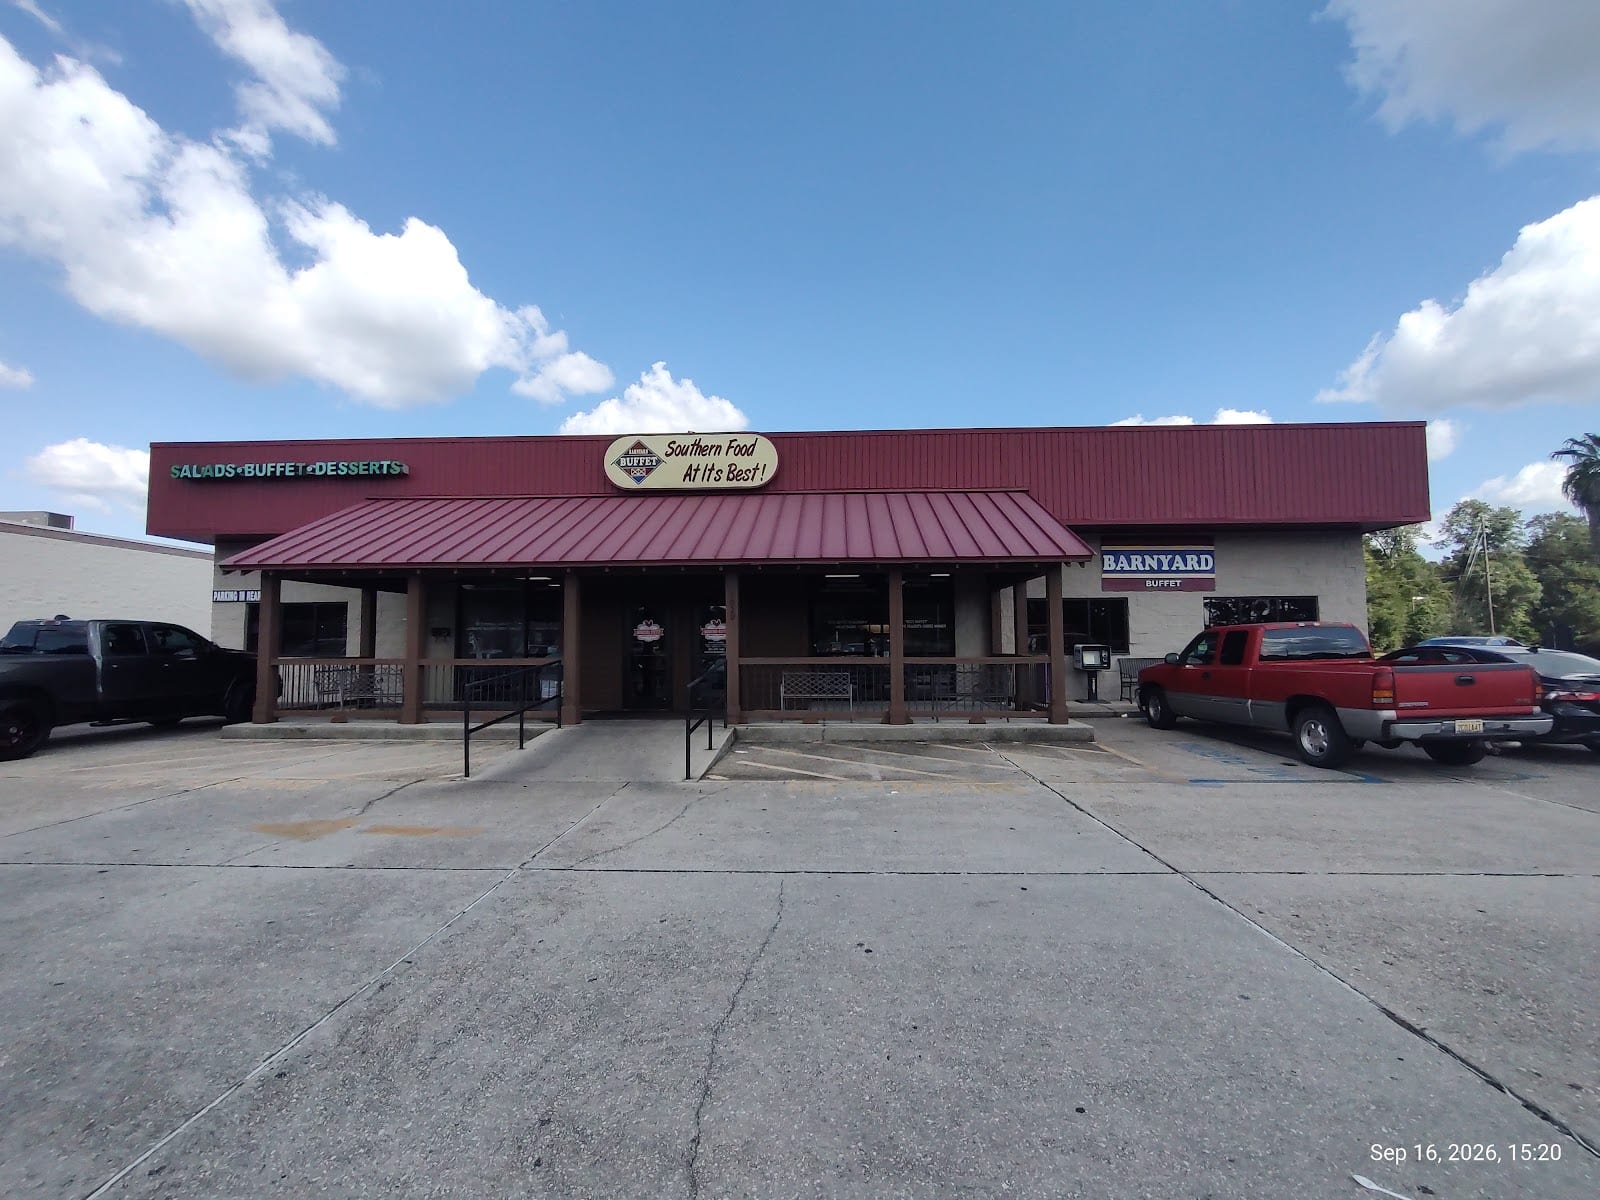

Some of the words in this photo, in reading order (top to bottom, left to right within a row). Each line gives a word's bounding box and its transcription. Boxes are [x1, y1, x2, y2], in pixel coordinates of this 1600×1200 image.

[664, 437, 722, 457] Southern
[725, 437, 758, 456] Food
[170, 463, 236, 478] SALADS
[244, 462, 303, 477] BUFFET
[315, 460, 401, 476] DESSERTS
[620, 457, 658, 467] BUFFET
[683, 463, 700, 482] At
[726, 463, 767, 482] Best!
[1103, 554, 1213, 571] BARNYARD
